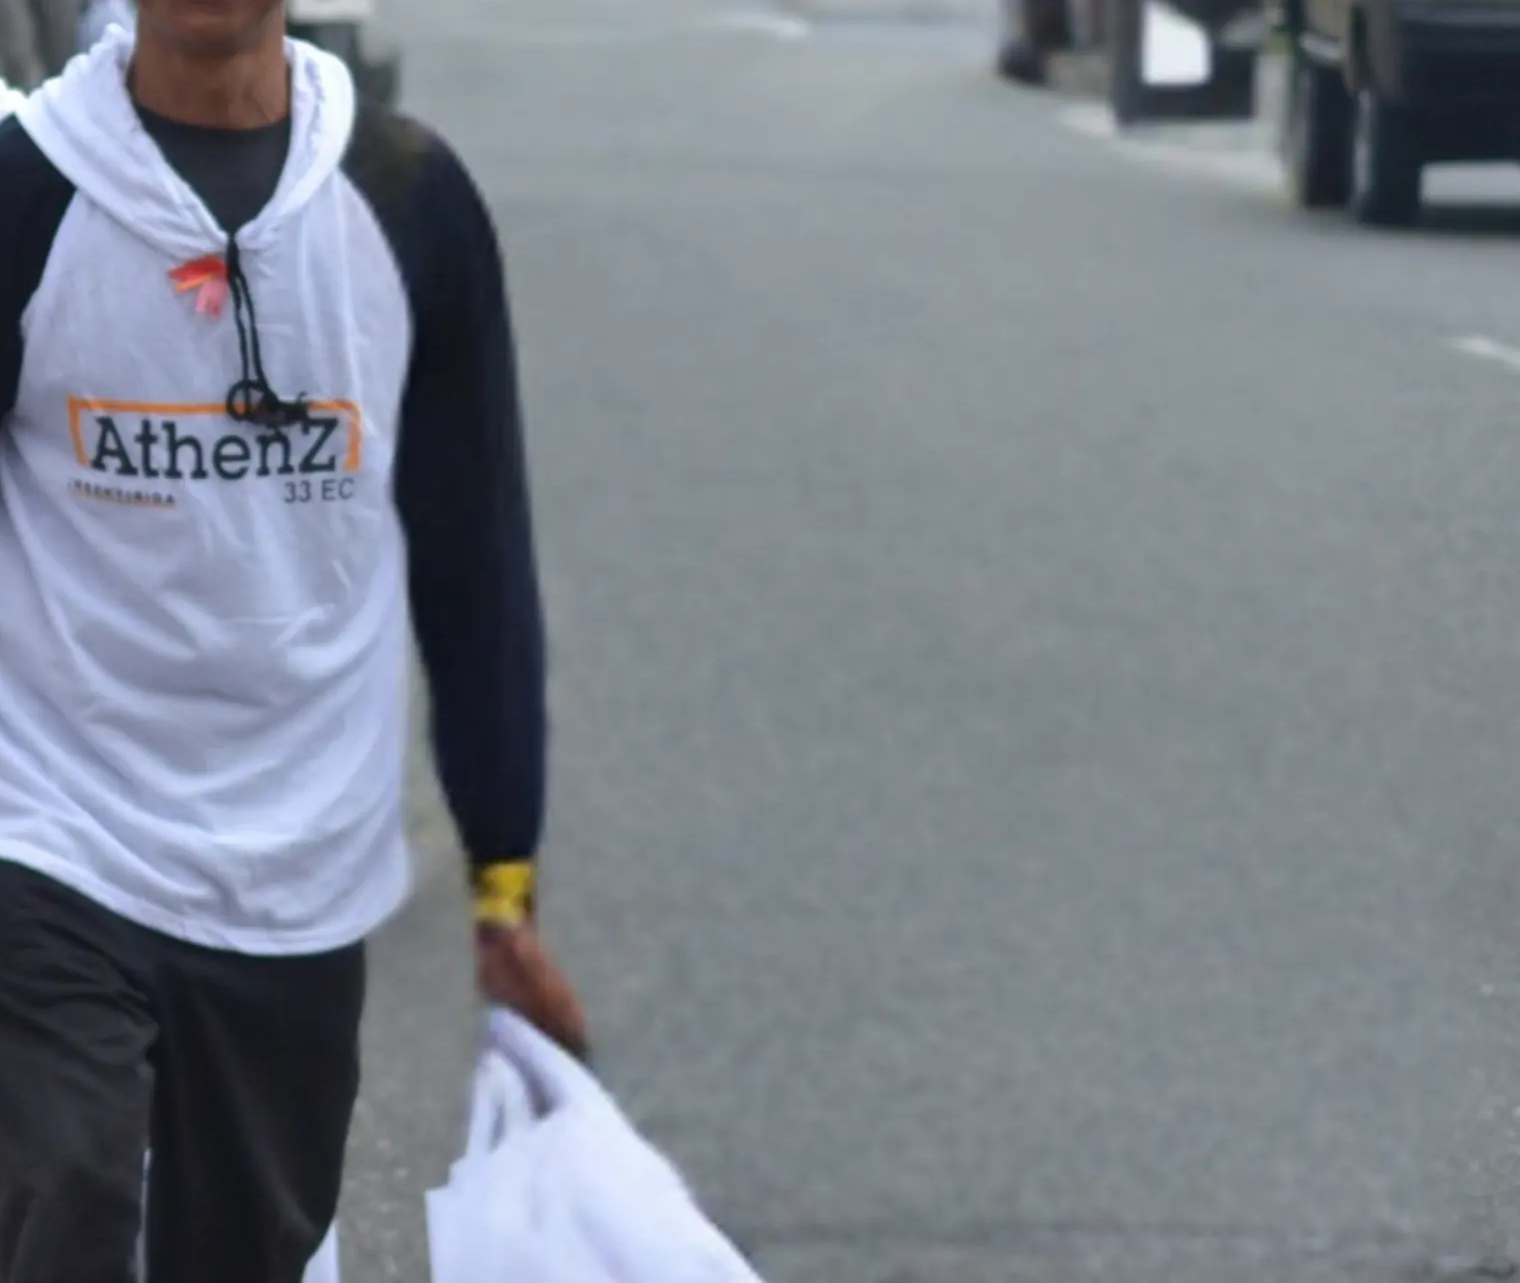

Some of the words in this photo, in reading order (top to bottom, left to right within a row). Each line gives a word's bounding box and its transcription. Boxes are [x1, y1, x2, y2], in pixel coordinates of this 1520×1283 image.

[91, 417, 339, 480] AthenZ
[284, 482, 311, 503] 33
[320, 478, 356, 501] EC
